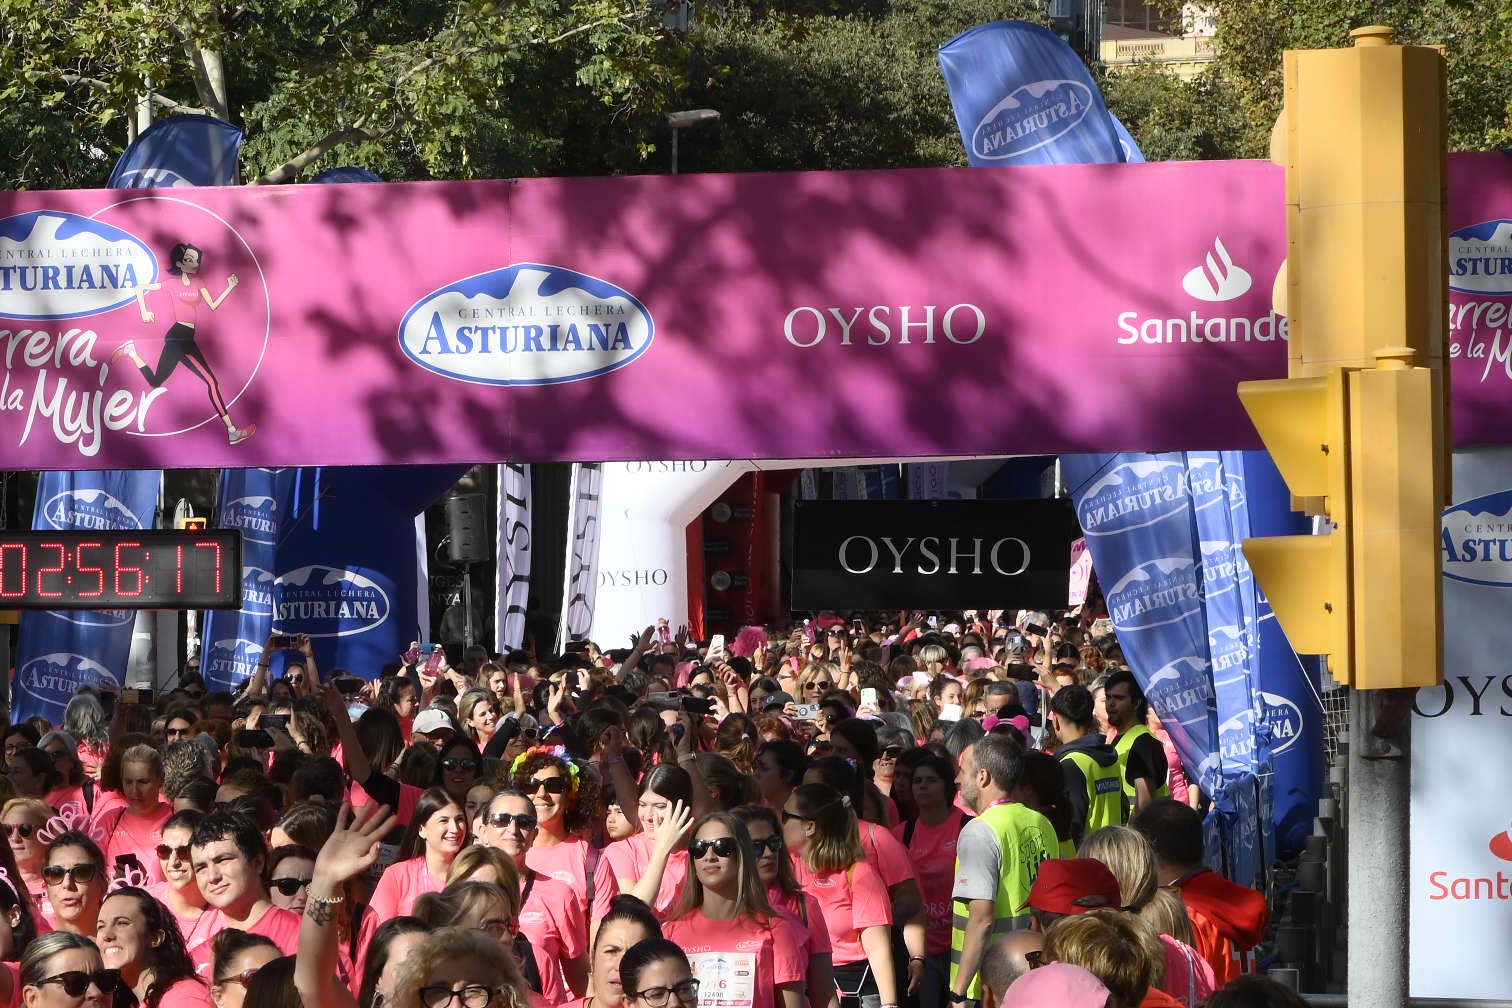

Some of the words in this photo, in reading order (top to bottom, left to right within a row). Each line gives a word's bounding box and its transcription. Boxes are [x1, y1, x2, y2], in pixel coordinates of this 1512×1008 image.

[59, 247, 132, 259] LECHERA
[418, 310, 634, 356] ASTURIANA
[458, 306, 535, 320] CENTRAL
[544, 304, 626, 318] LECHERA
[783, 303, 987, 348] OYSHO
[1117, 309, 1289, 345] Santande
[0, 371, 24, 411] la
[19, 363, 168, 457] Mujer
[0, 543, 220, 598] 02:56:17
[838, 535, 1031, 576] OYSHO
